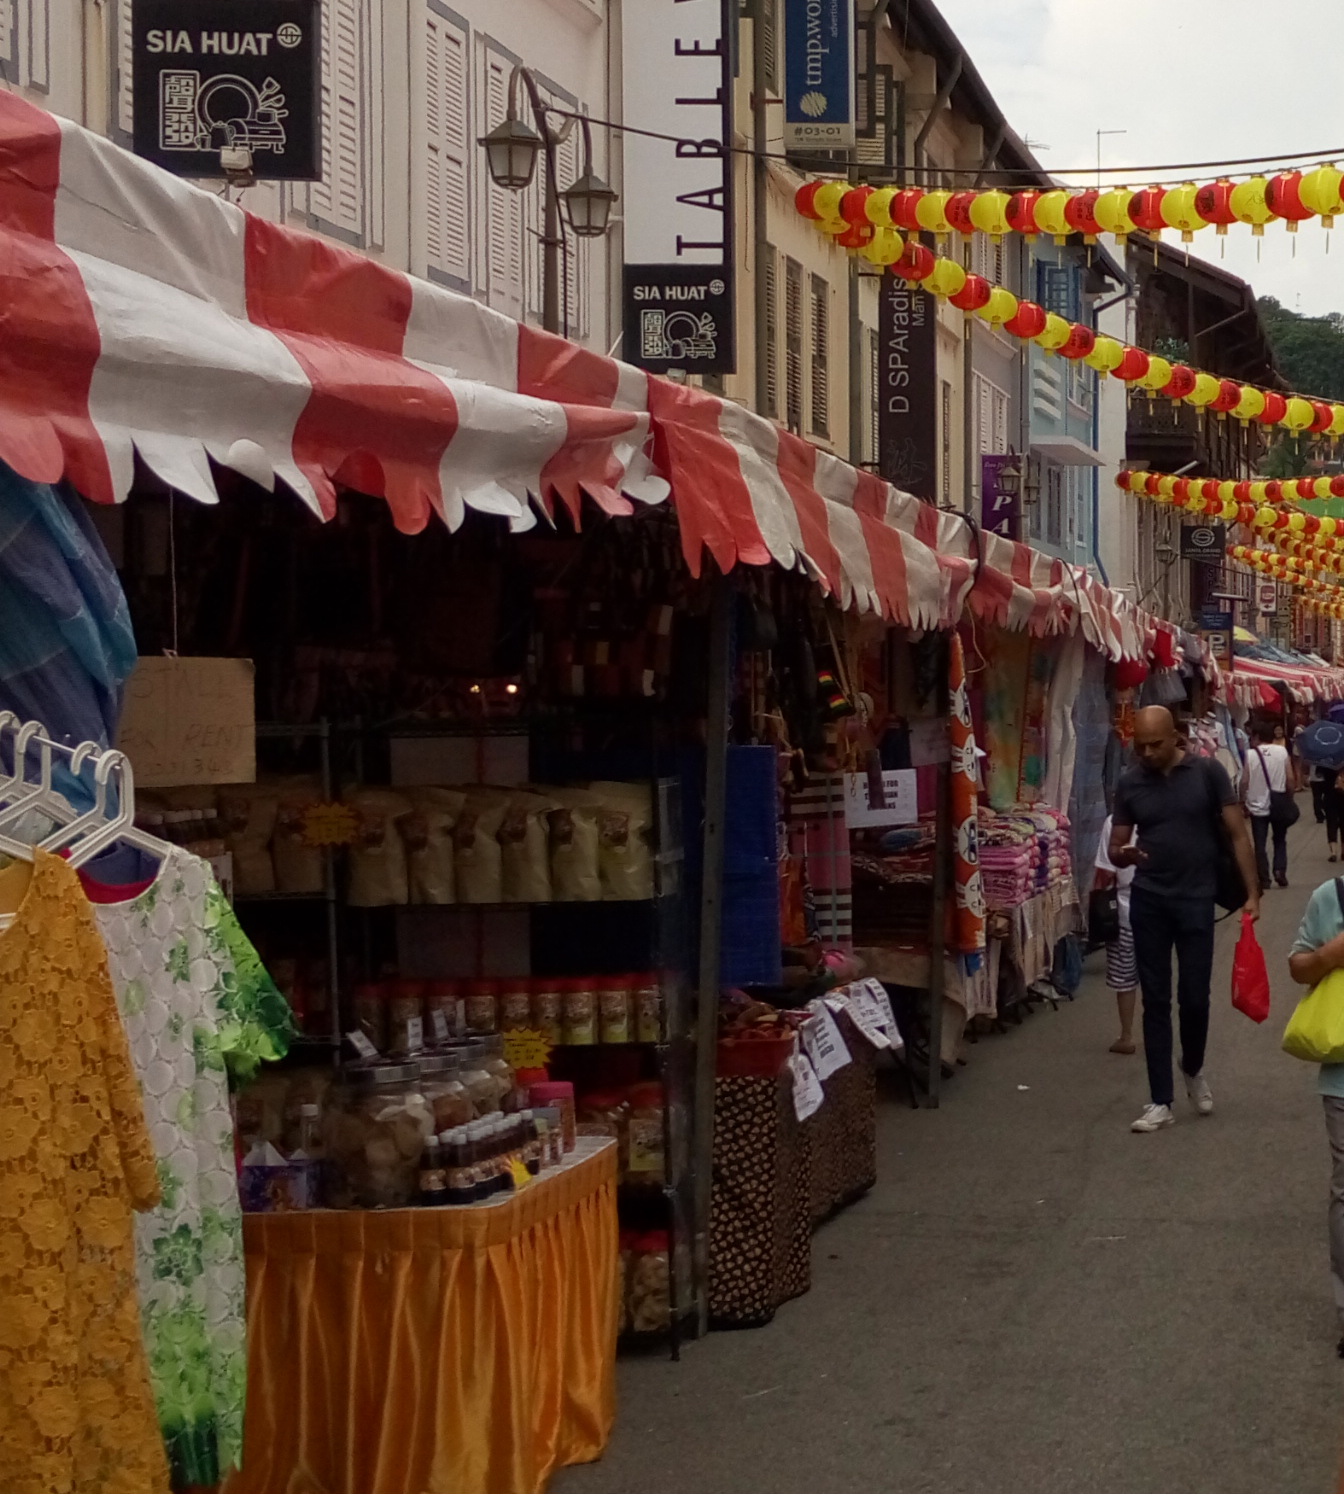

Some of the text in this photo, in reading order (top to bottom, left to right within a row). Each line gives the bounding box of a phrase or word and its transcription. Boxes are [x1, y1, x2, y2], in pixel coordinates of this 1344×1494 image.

[145, 30, 273, 56] SIA HUAT
[793, 126, 841, 136] #03-01
[633, 286, 708, 301] SIA HUAT
